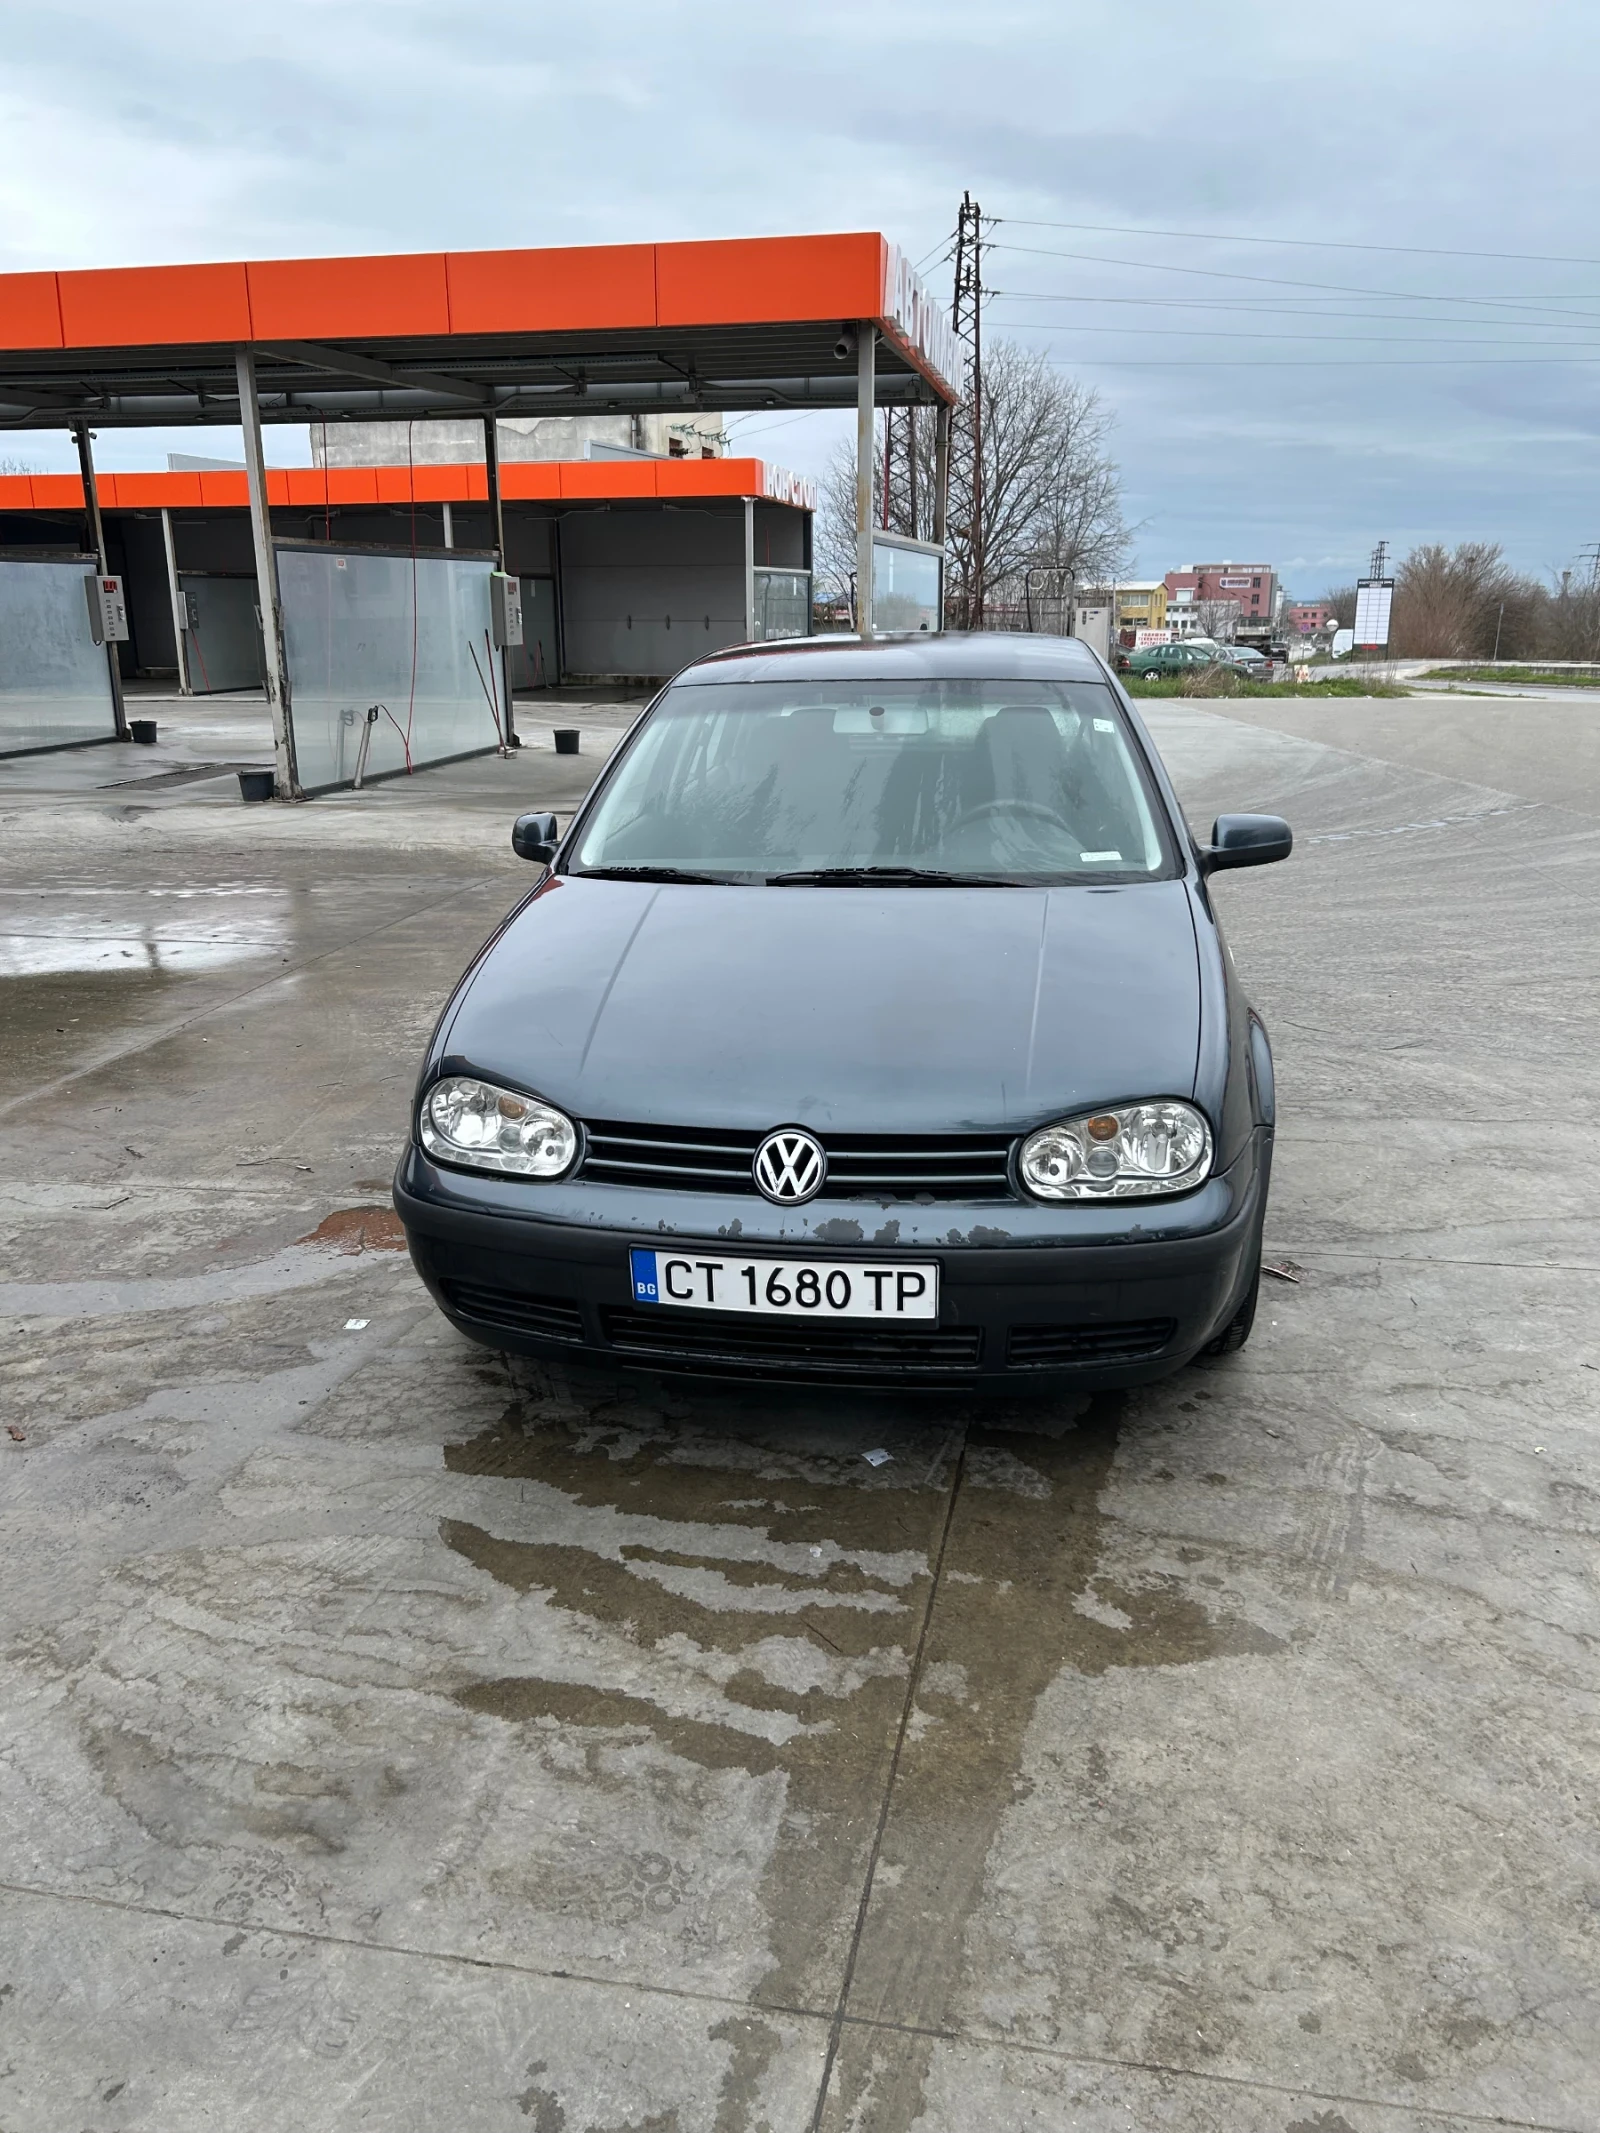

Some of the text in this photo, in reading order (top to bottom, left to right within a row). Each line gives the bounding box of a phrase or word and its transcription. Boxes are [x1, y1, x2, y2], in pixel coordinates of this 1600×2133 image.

[757, 1133, 822, 1199] VW
[637, 1282, 656, 1295] BG
[665, 1259, 926, 1311] CT 1680 TP
